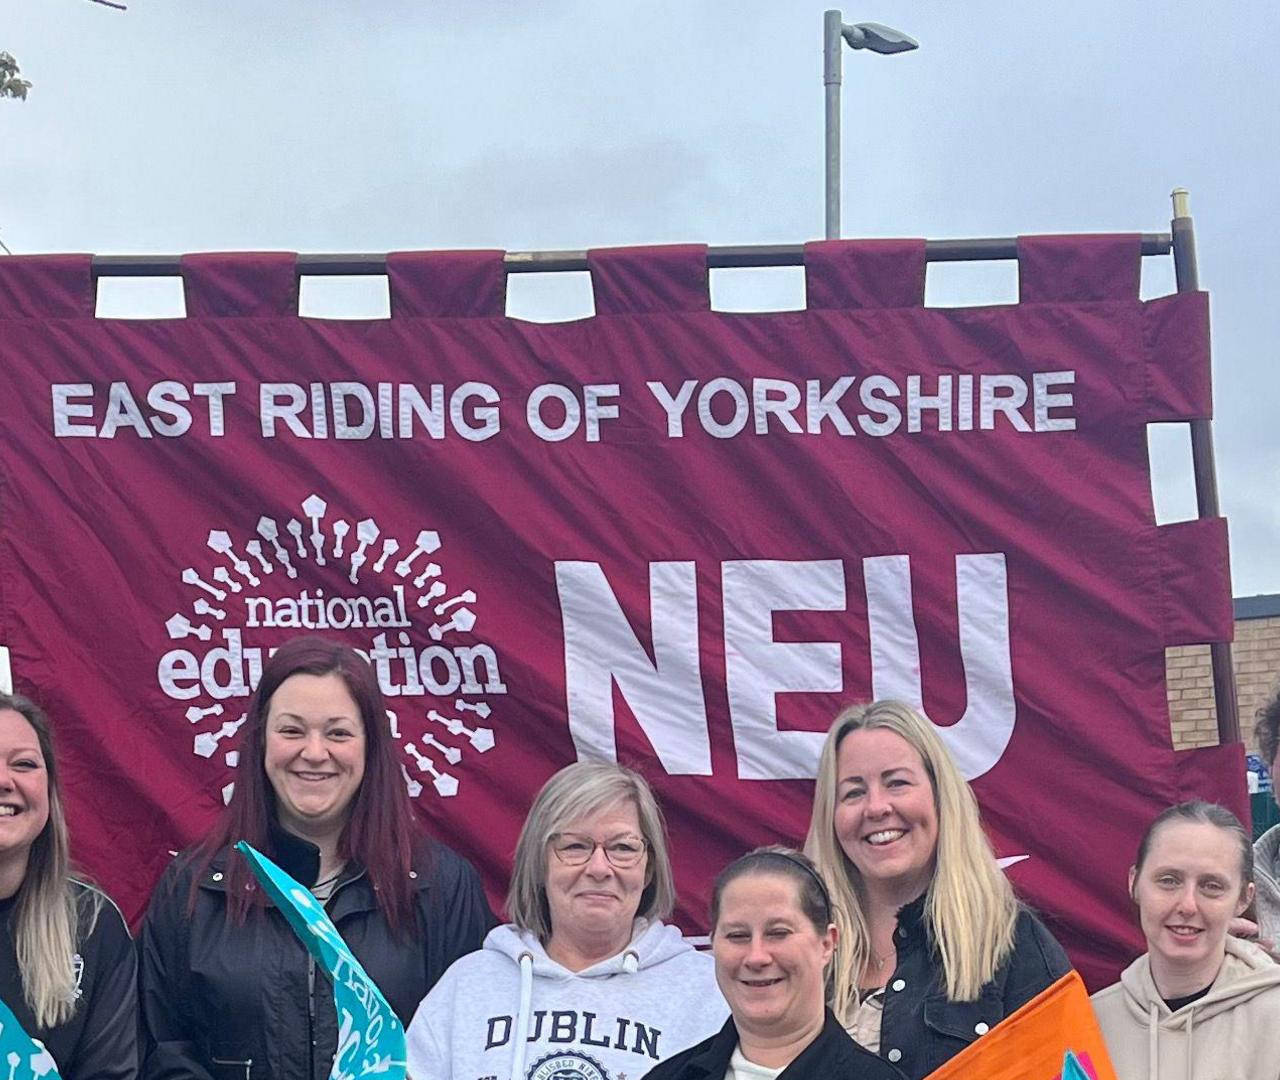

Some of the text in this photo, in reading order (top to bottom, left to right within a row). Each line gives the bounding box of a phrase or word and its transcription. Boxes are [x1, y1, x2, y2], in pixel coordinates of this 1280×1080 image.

[51, 370, 1077, 442] EAST RIDING OF YORKSHIRE
[245, 585, 412, 629] national
[158, 627, 507, 700] edution
[554, 552, 1017, 782] NEU
